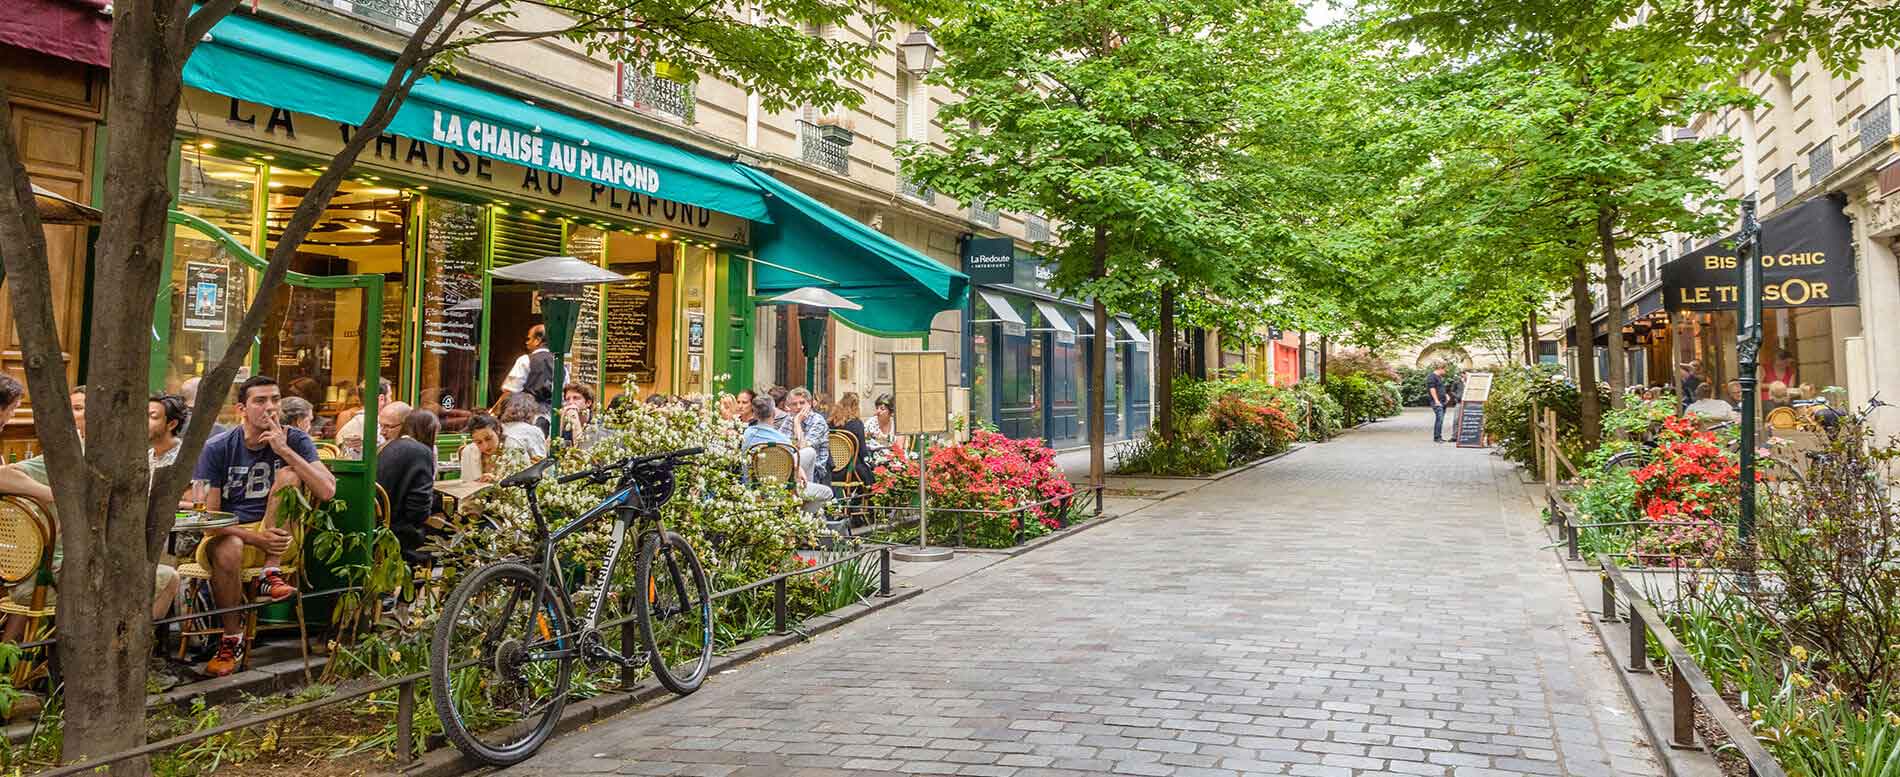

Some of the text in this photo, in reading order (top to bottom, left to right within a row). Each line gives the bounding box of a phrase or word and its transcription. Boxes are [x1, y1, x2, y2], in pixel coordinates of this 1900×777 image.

[228, 97, 296, 139] LA
[522, 167, 562, 195] AU
[433, 110, 659, 193] LA CHAISE AU PLAFOND
[970, 254, 1010, 264] La Redoute
[1704, 252, 1825, 270] BISO CHIC
[1680, 279, 1829, 305] LE TSOR
[586, 538, 617, 620] ROCKRIDER
